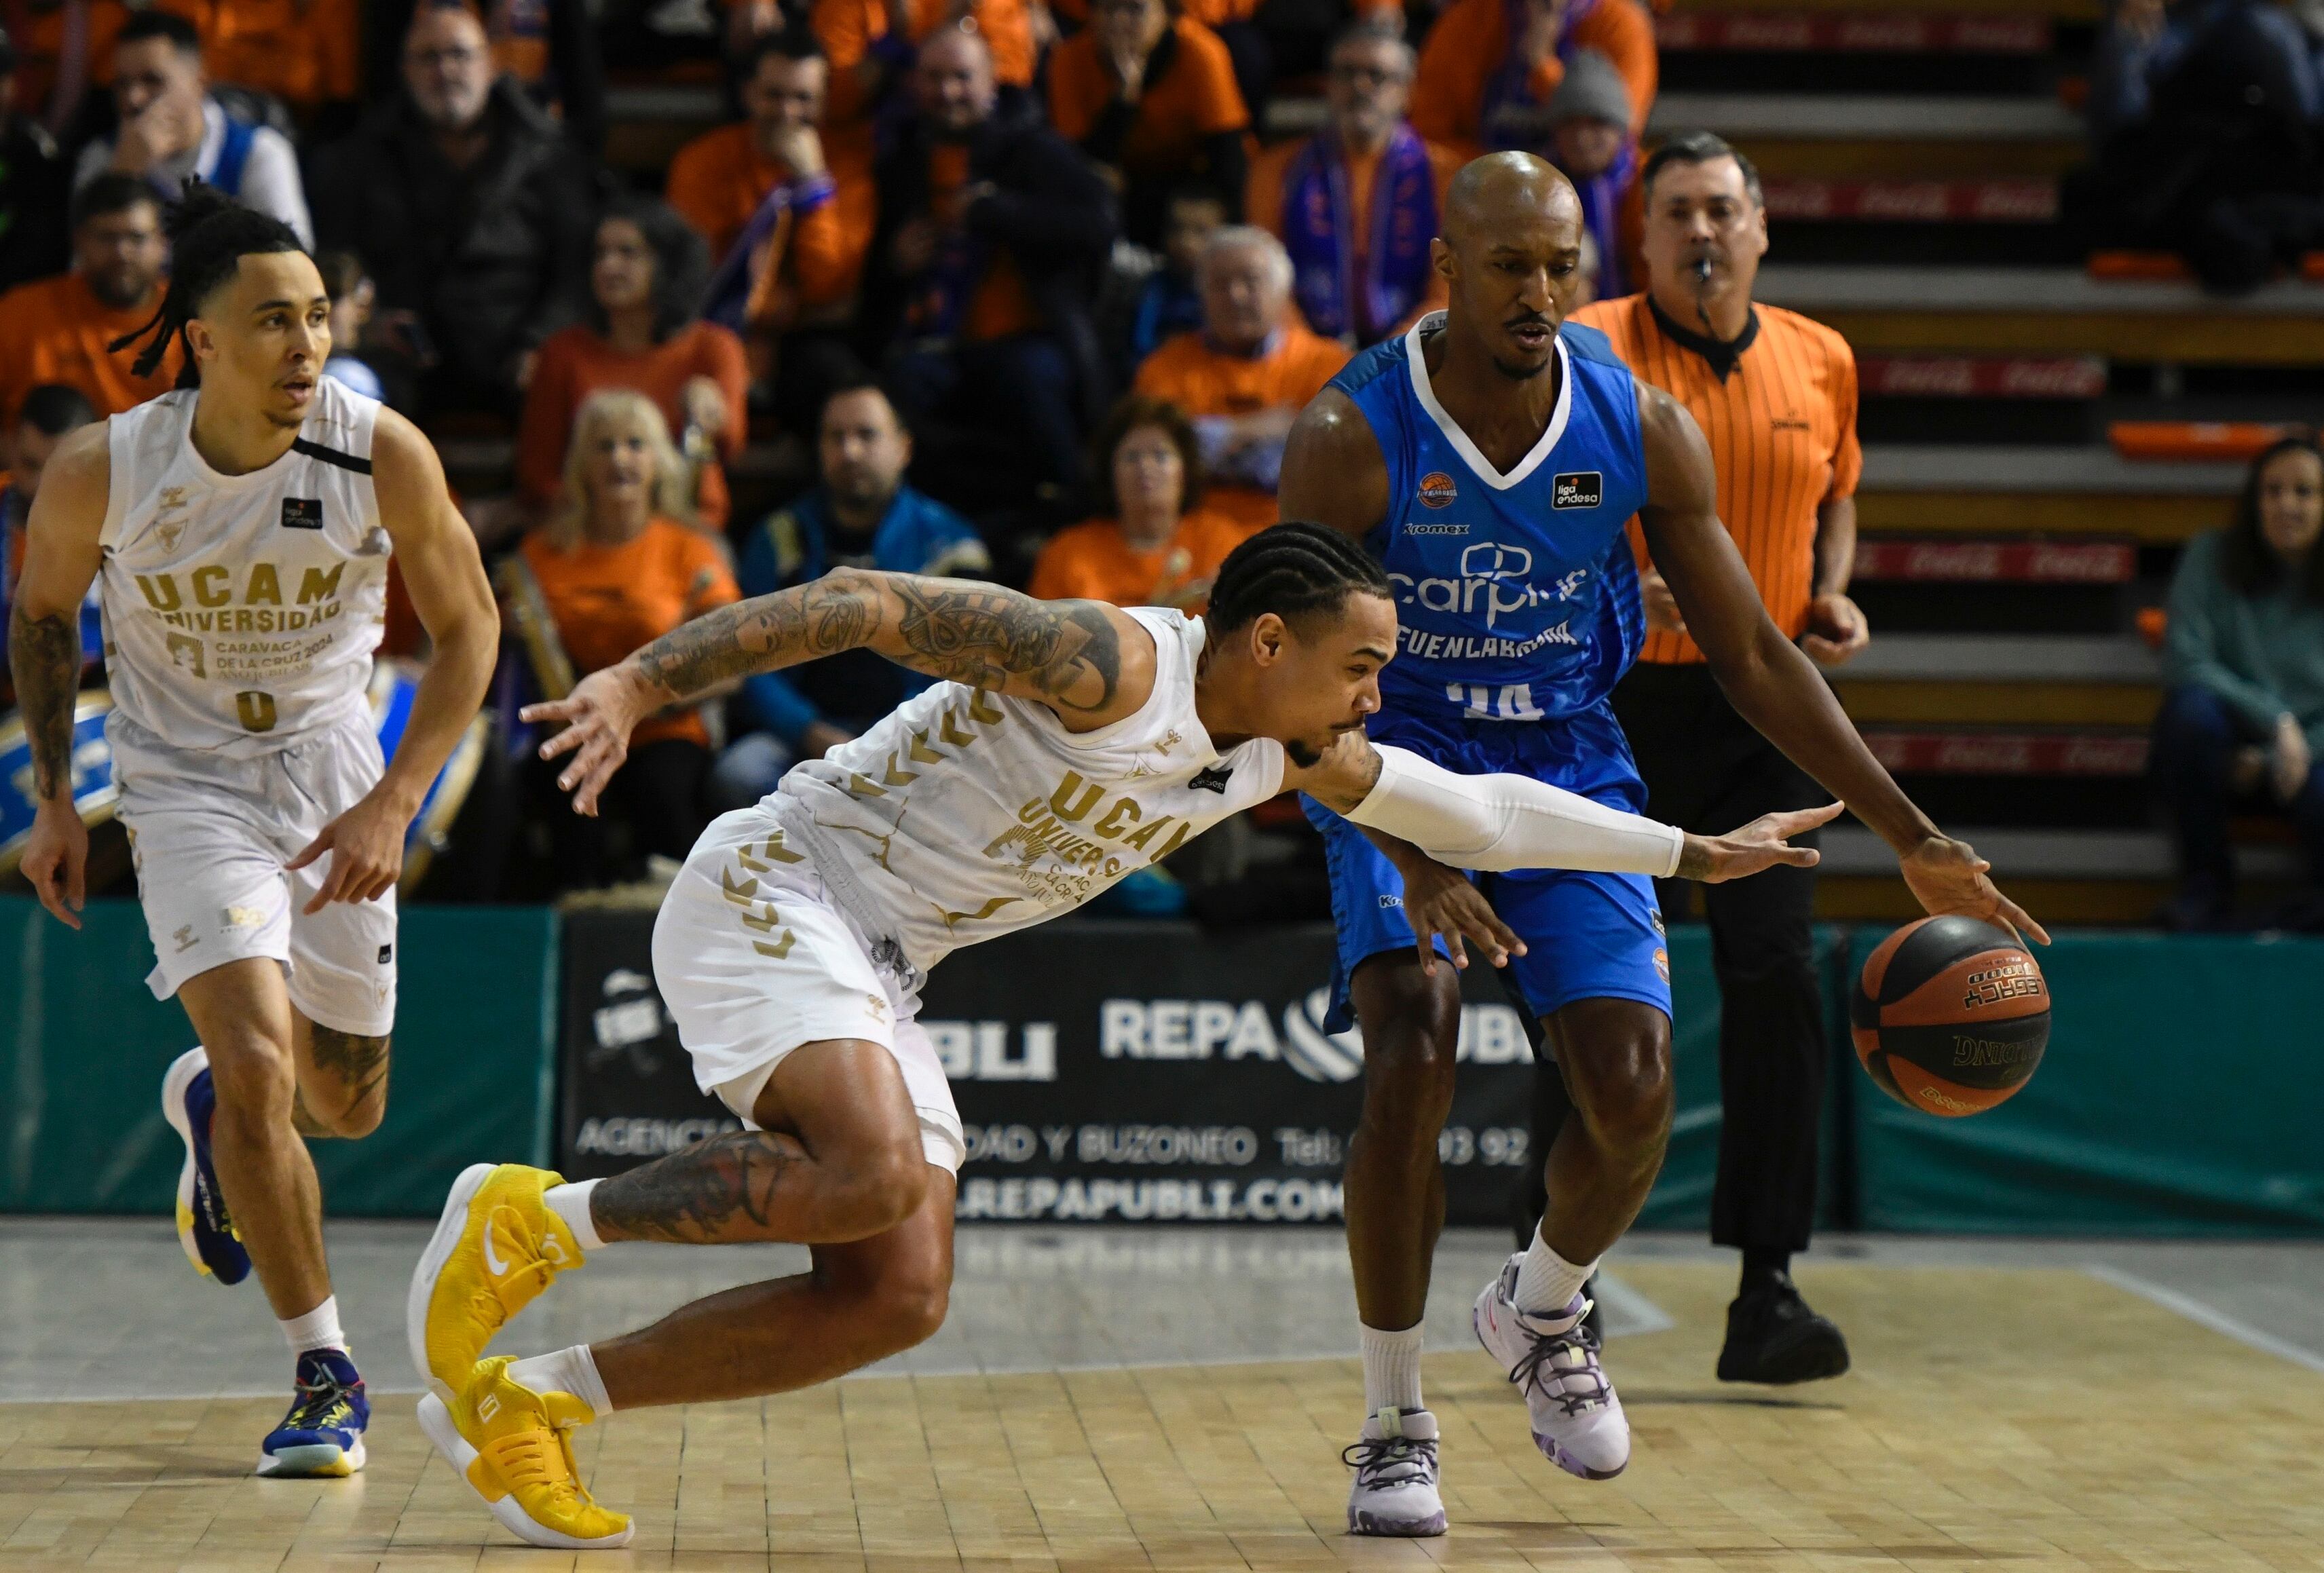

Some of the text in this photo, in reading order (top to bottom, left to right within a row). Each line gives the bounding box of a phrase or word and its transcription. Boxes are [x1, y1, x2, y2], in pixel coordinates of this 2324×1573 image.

[1557, 493, 1598, 505] endesa
[1558, 484, 1576, 496] liga
[134, 561, 347, 611] UCAM
[215, 639, 302, 654] CARAVACA
[217, 658, 236, 668] DE
[261, 650, 301, 667] CRUZ
[236, 690, 278, 733] 0
[1100, 998, 1281, 1061] REPA
[1041, 1124, 1072, 1164] Y
[1077, 1124, 1258, 1166] BUZONEO
